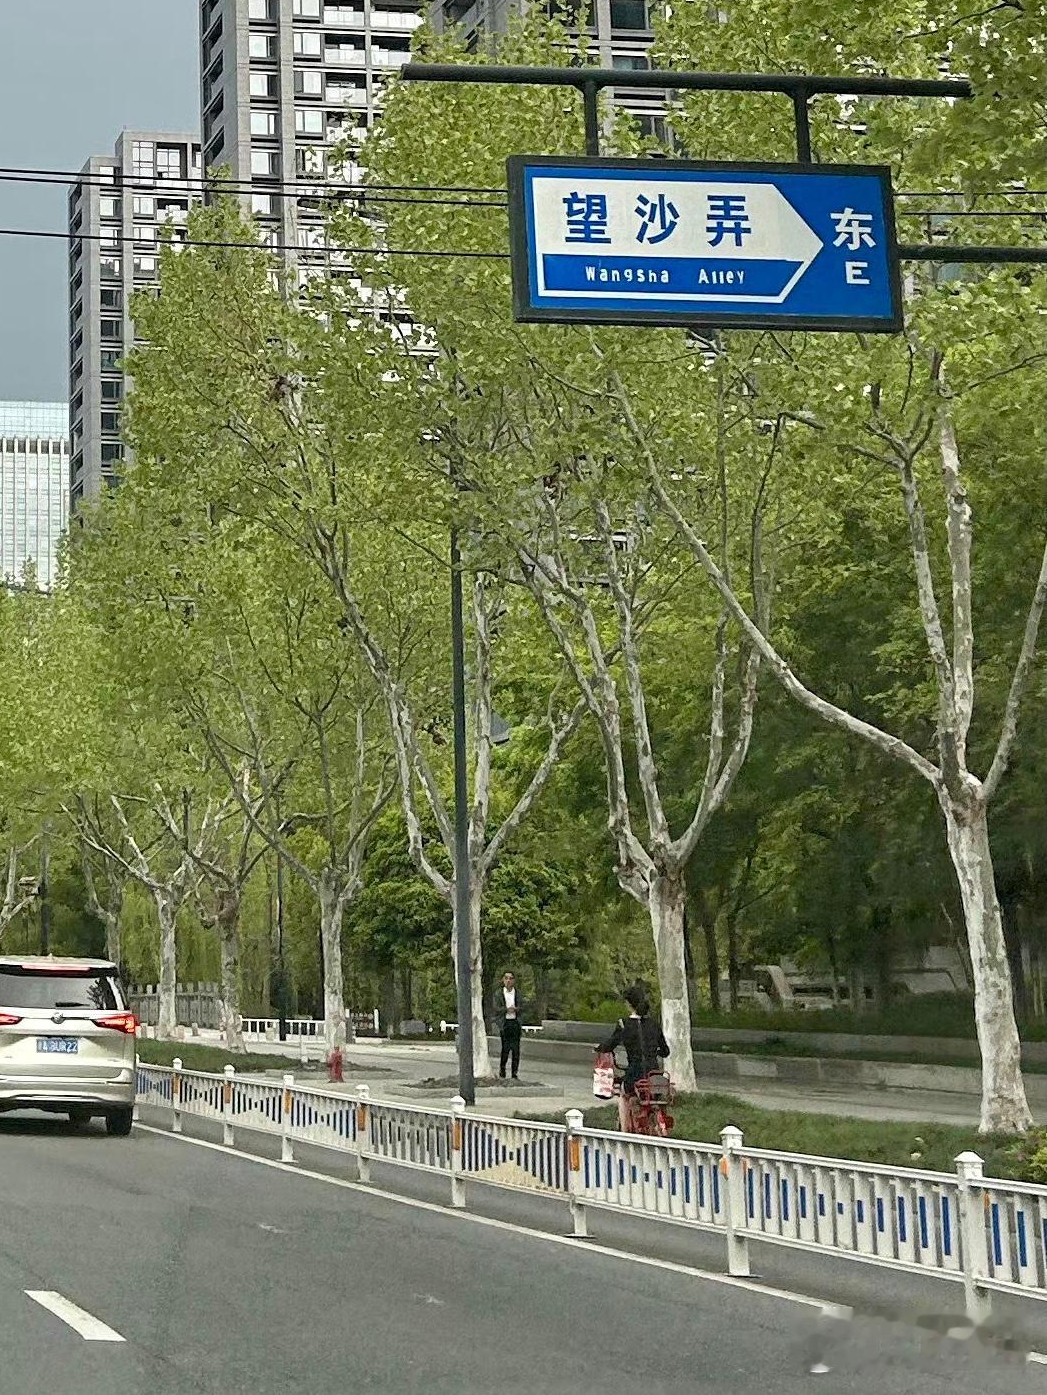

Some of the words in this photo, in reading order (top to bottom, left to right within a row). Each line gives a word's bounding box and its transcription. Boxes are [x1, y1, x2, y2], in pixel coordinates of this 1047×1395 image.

[562, 192, 751, 248] 望沙弄
[830, 207, 877, 251] 东
[585, 265, 670, 284] Wangsha
[698, 268, 746, 285] Alley
[845, 261, 870, 285] E
